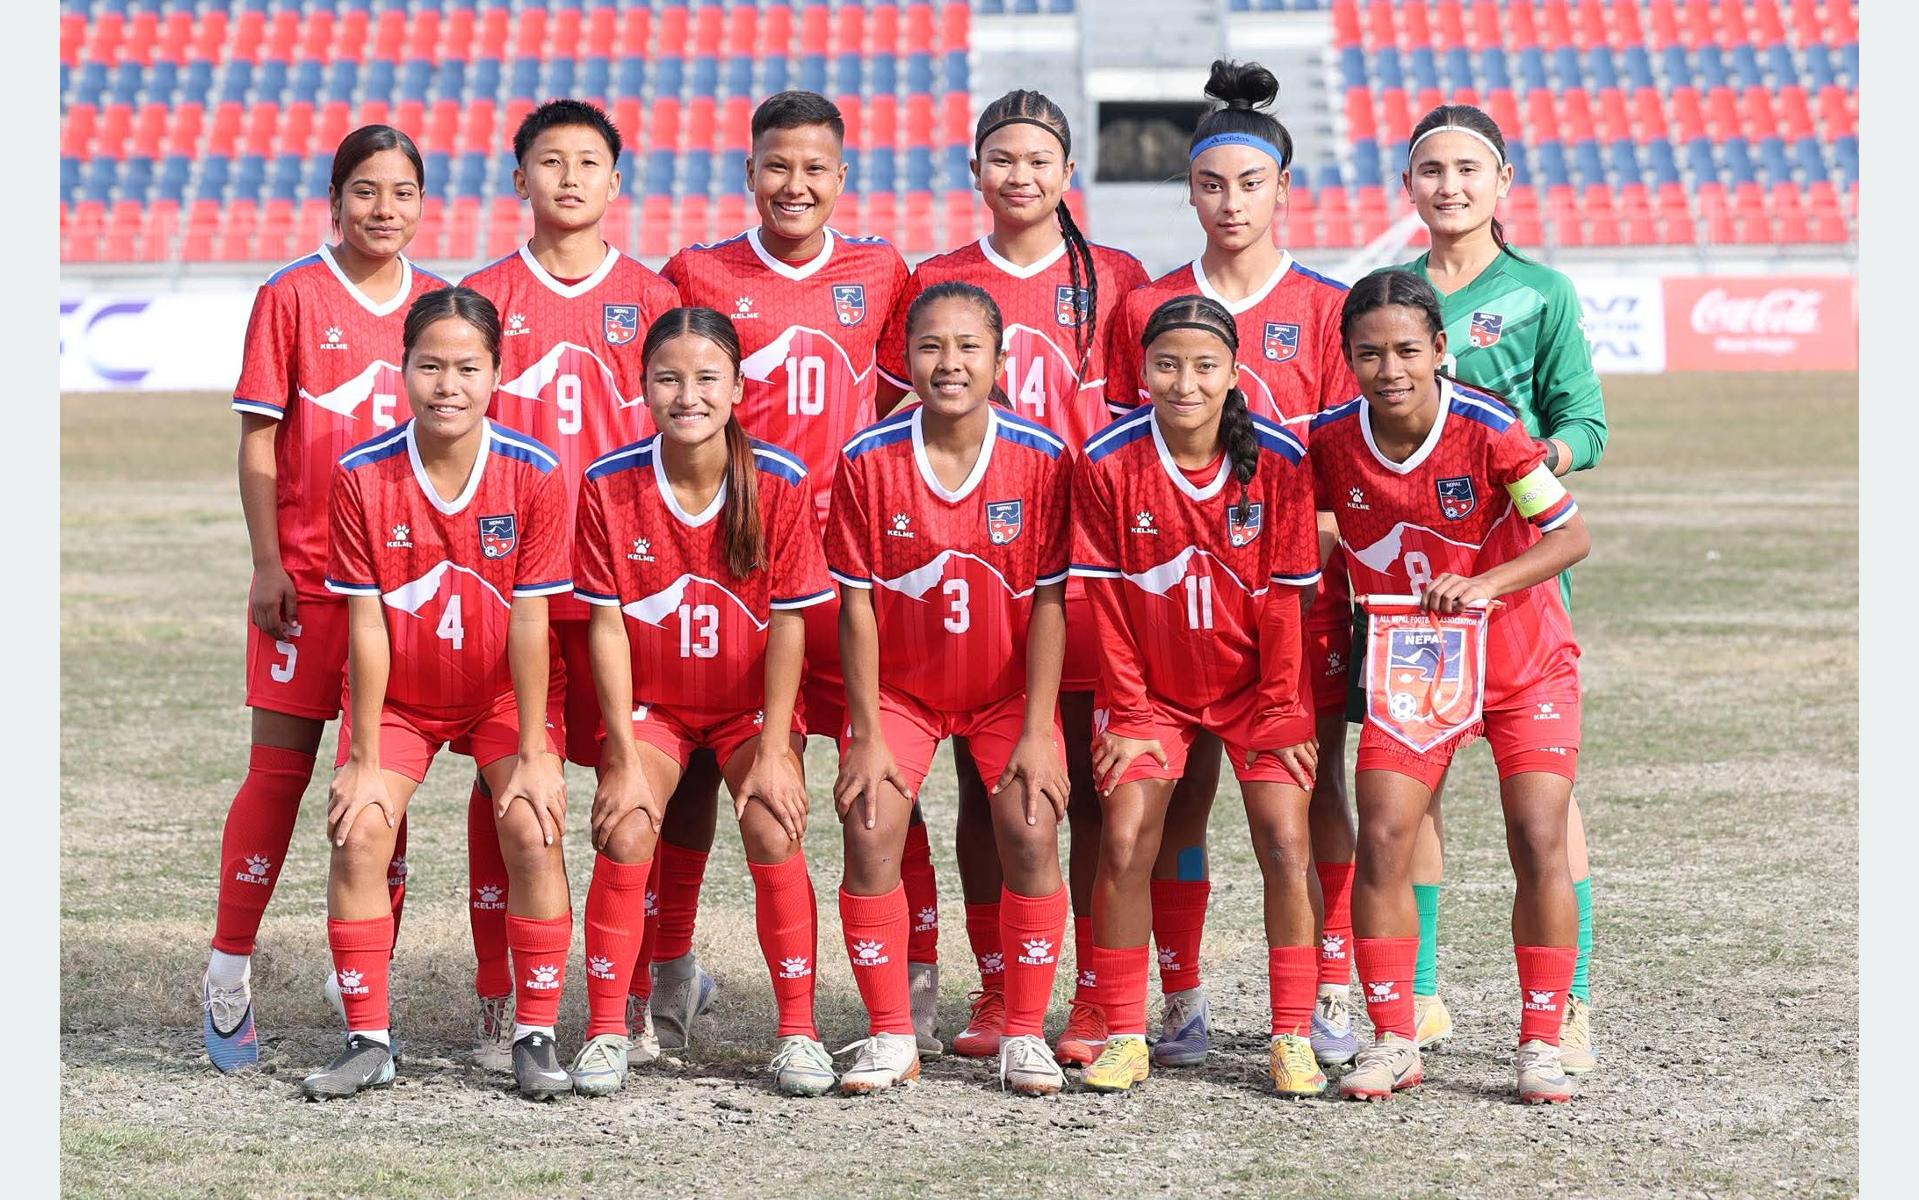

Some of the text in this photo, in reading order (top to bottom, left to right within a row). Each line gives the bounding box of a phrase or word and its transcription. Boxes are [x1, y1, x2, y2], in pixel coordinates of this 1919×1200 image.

[1220, 135, 1250, 143] adidas
[504, 328, 530, 336] KELME
[786, 356, 826, 416] 10
[1005, 356, 1046, 417] 14
[556, 374, 582, 435] 9
[372, 393, 397, 431] 5
[1347, 502, 1371, 511] KELME
[887, 530, 915, 539] KELME
[1130, 527, 1158, 535] KELME
[386, 541, 413, 549] KELME
[627, 553, 655, 562] KELME
[1404, 551, 1432, 597] 8
[943, 579, 970, 634] 3
[1185, 575, 1213, 630] 11
[436, 595, 464, 650] 4
[1380, 616, 1391, 624] ALL
[1391, 615, 1409, 624] NEPAL
[679, 604, 719, 658] 13
[1325, 664, 1347, 676] KELME
[1533, 713, 1561, 721] KELME
[236, 872, 270, 886] KELME
[473, 901, 506, 910] KELME
[1018, 955, 1055, 965] KELME
[1322, 951, 1346, 959] ELME
[853, 956, 889, 966] KELME
[587, 968, 616, 980] KELME
[779, 968, 812, 979] KELME
[980, 963, 1005, 975] KELM
[526, 980, 560, 990] KELME
[1078, 978, 1097, 988] KEL
[339, 985, 370, 994] KELME
[1368, 992, 1401, 1003] KELME
[1525, 1002, 1557, 1012] KELME
